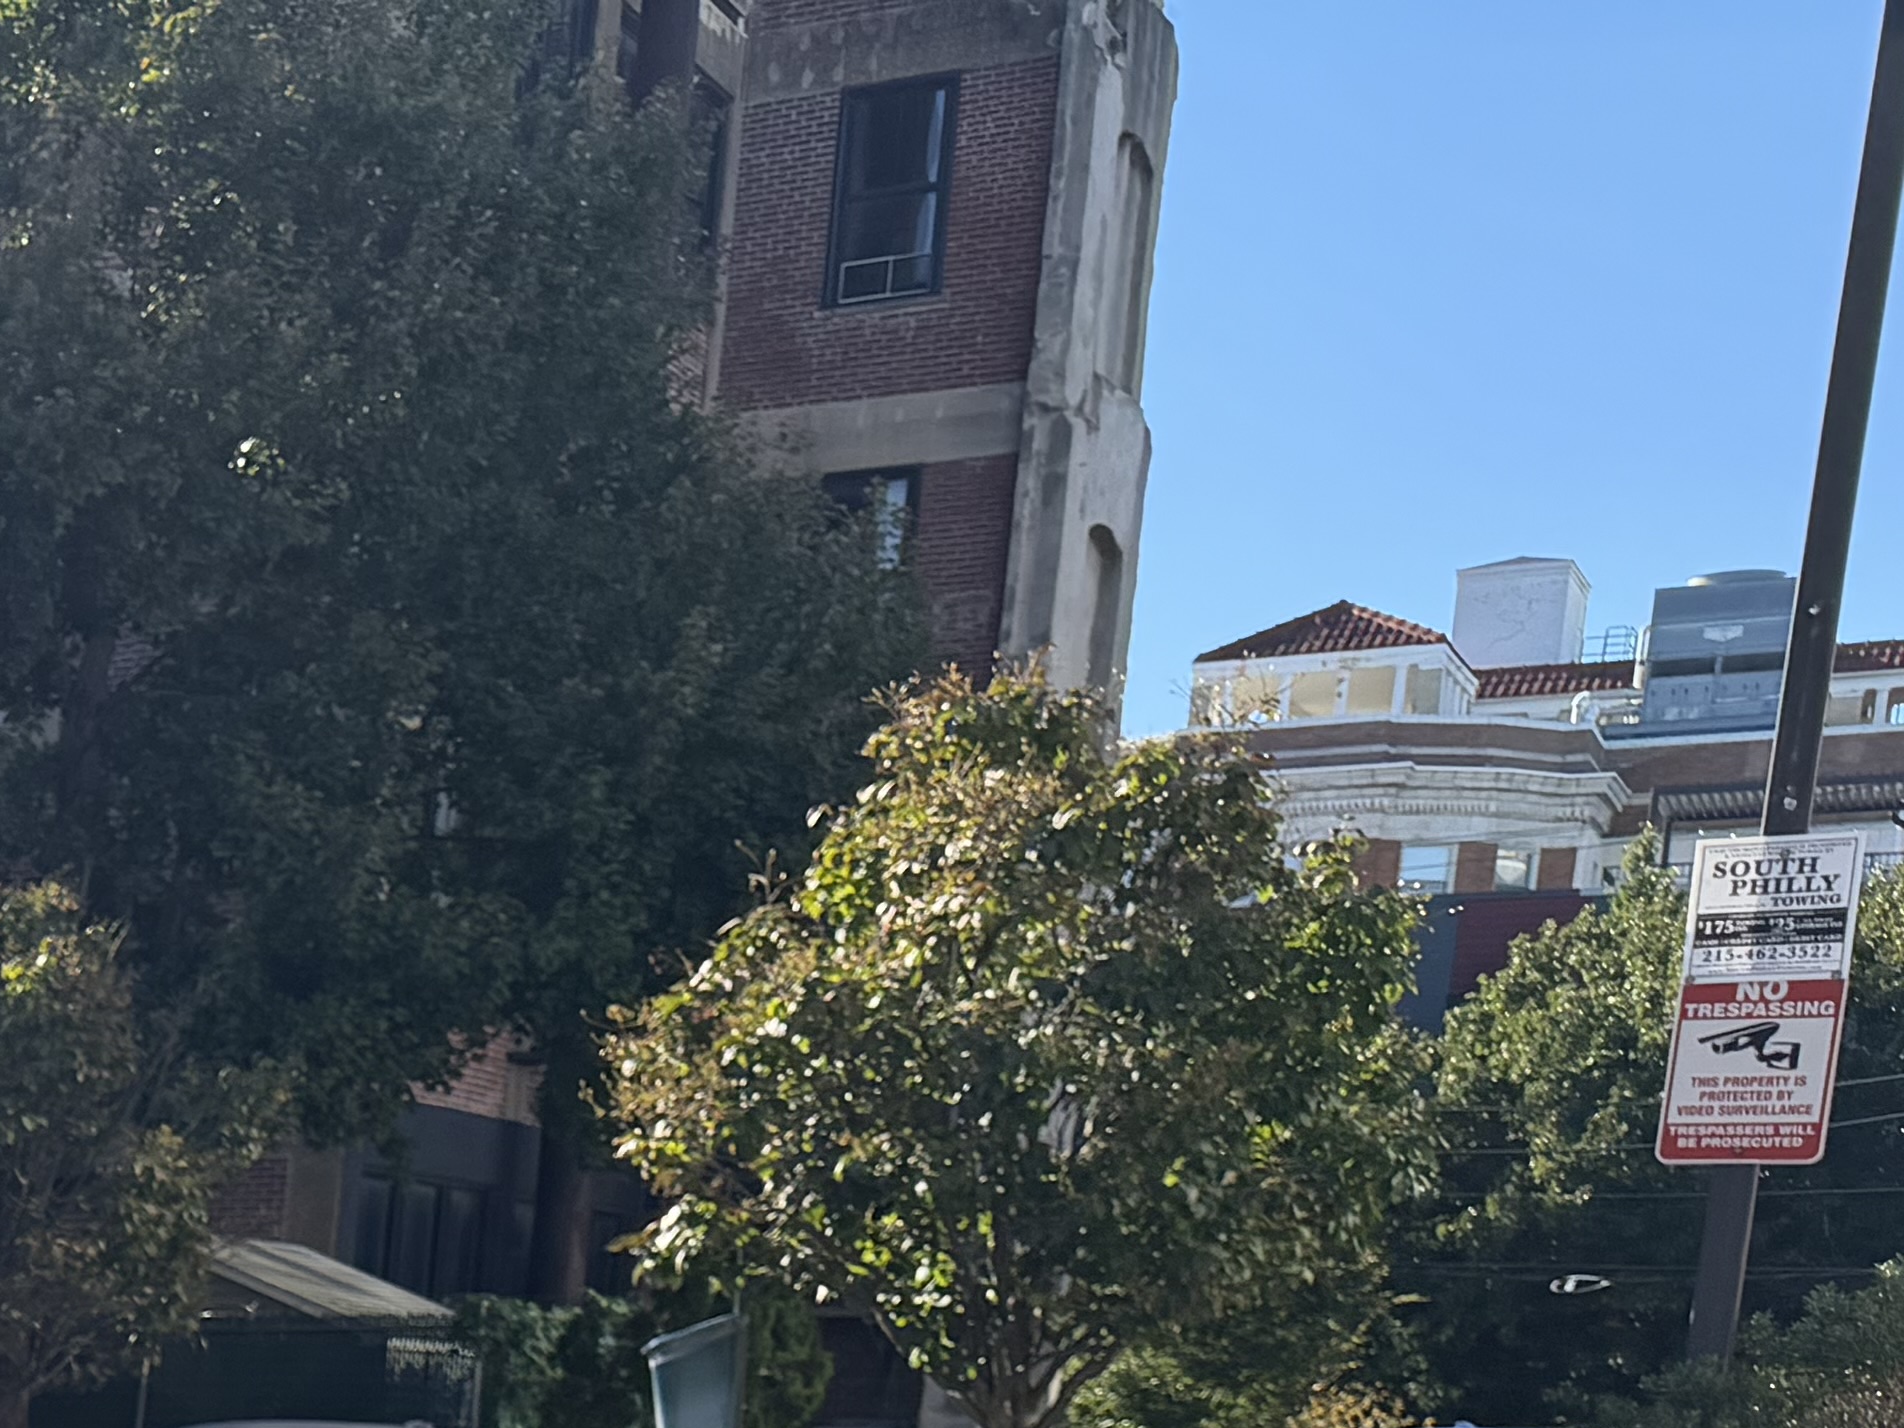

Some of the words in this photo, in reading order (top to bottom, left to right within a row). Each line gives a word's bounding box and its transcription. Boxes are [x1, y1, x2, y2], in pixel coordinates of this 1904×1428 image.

[1712, 856, 1820, 879] SOUTH
[1729, 874, 1841, 896] PHILLY
[1770, 894, 1842, 907] TOWING
[1736, 981, 1789, 1001] NO
[1684, 1000, 1836, 1018] TRESPASSING
[1691, 1076, 1720, 1088] THIS
[1723, 1076, 1791, 1087] PROPERTY
[1794, 1075, 1807, 1087] IS
[1699, 1090, 1773, 1102] PROTECTED
[1776, 1090, 1794, 1101] BY
[1677, 1105, 1714, 1116] VIDEO
[1718, 1104, 1813, 1116] SURVEILLANCE
[1669, 1125, 1776, 1136] TRESPASSERS
[1778, 1124, 1816, 1136] WILL
[1676, 1137, 1698, 1148] BE
[1701, 1136, 1804, 1148] PROSECUTED
